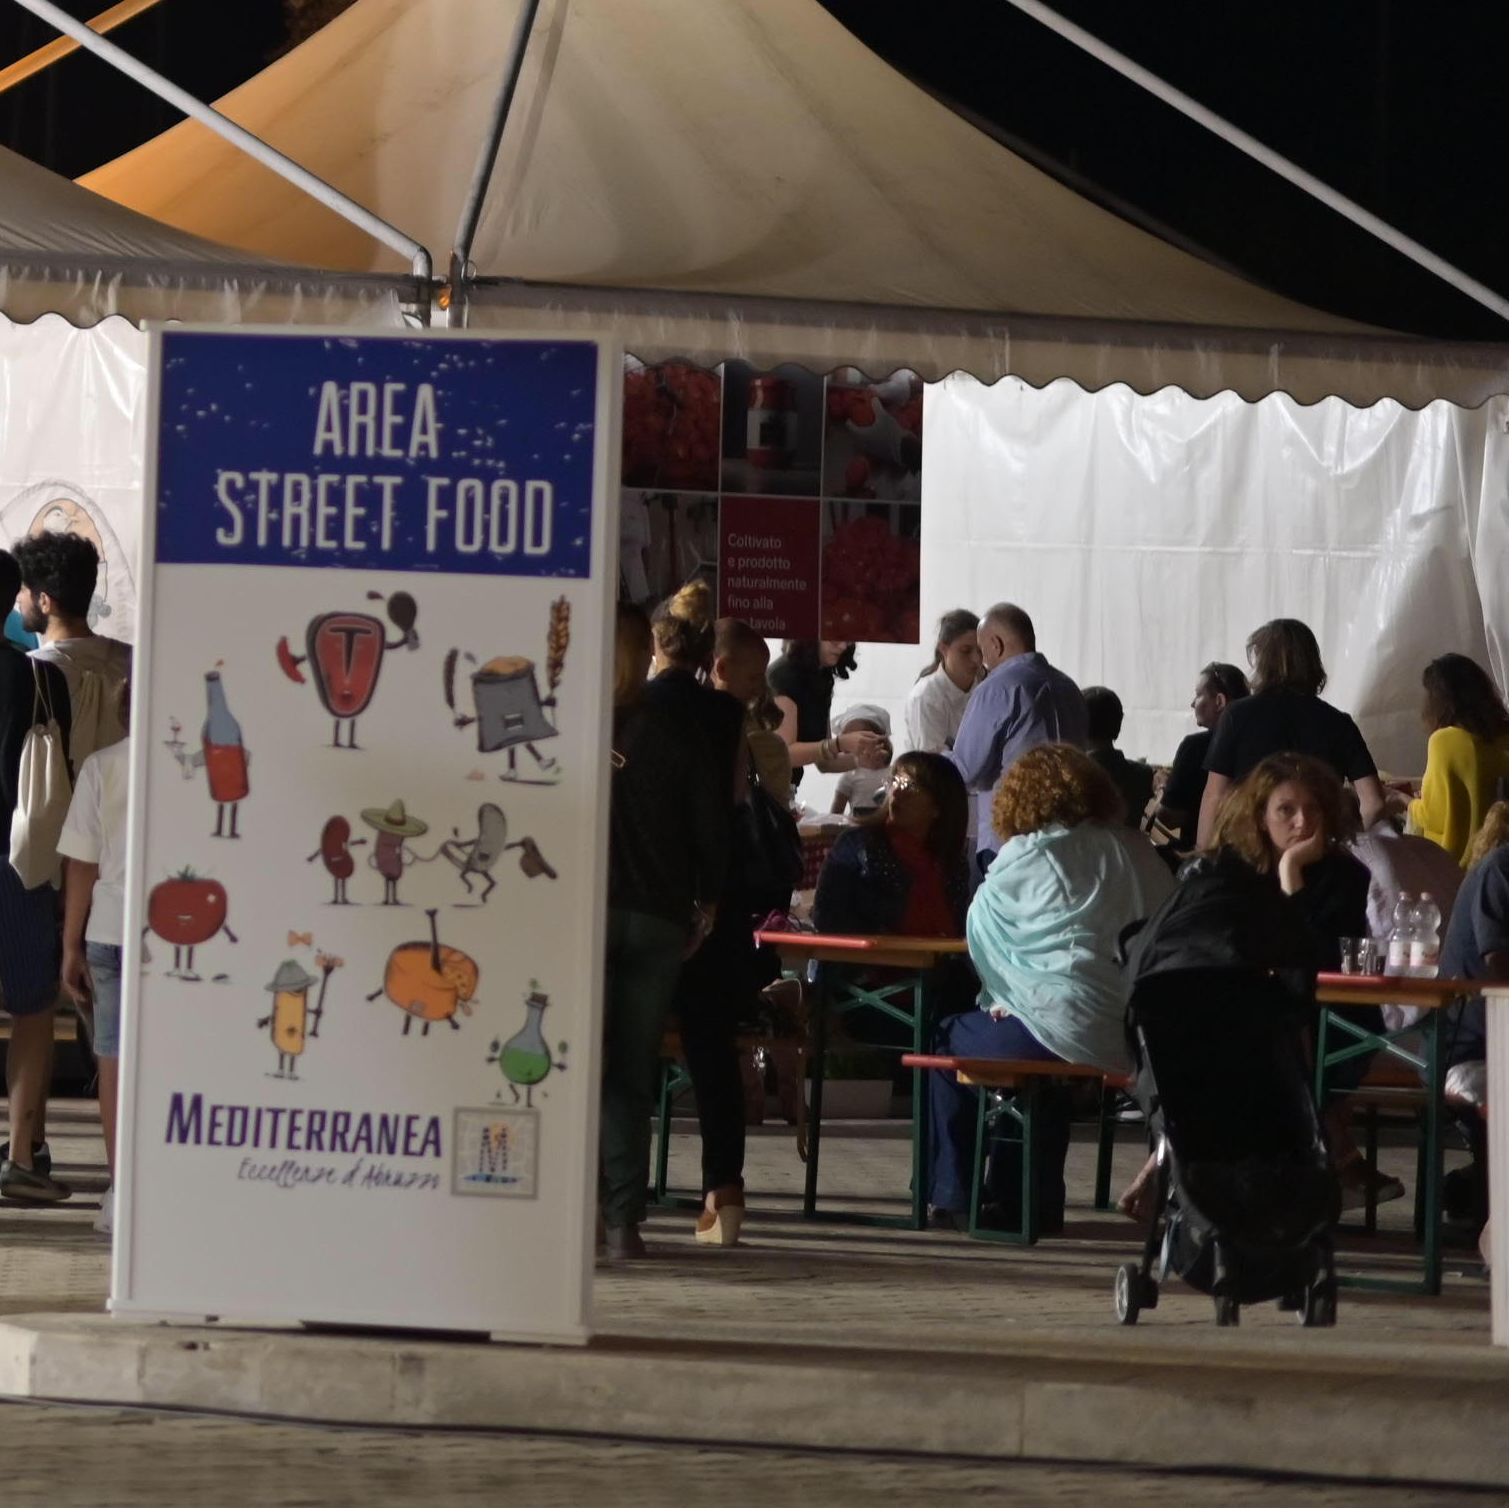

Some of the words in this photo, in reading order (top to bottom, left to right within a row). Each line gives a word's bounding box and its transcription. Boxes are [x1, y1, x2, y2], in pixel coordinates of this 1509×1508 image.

[313, 381, 440, 459] AREA
[216, 471, 404, 552] STREET
[426, 477, 553, 556] FOOD
[728, 533, 782, 548] Coltivato
[728, 557, 735, 567] e
[738, 556, 791, 570] prodotto
[727, 575, 807, 590] naturalmente
[728, 594, 750, 608] fino
[753, 596, 774, 610] alla
[750, 617, 786, 630] tavola
[164, 1092, 443, 1159] MEDITERRANEA
